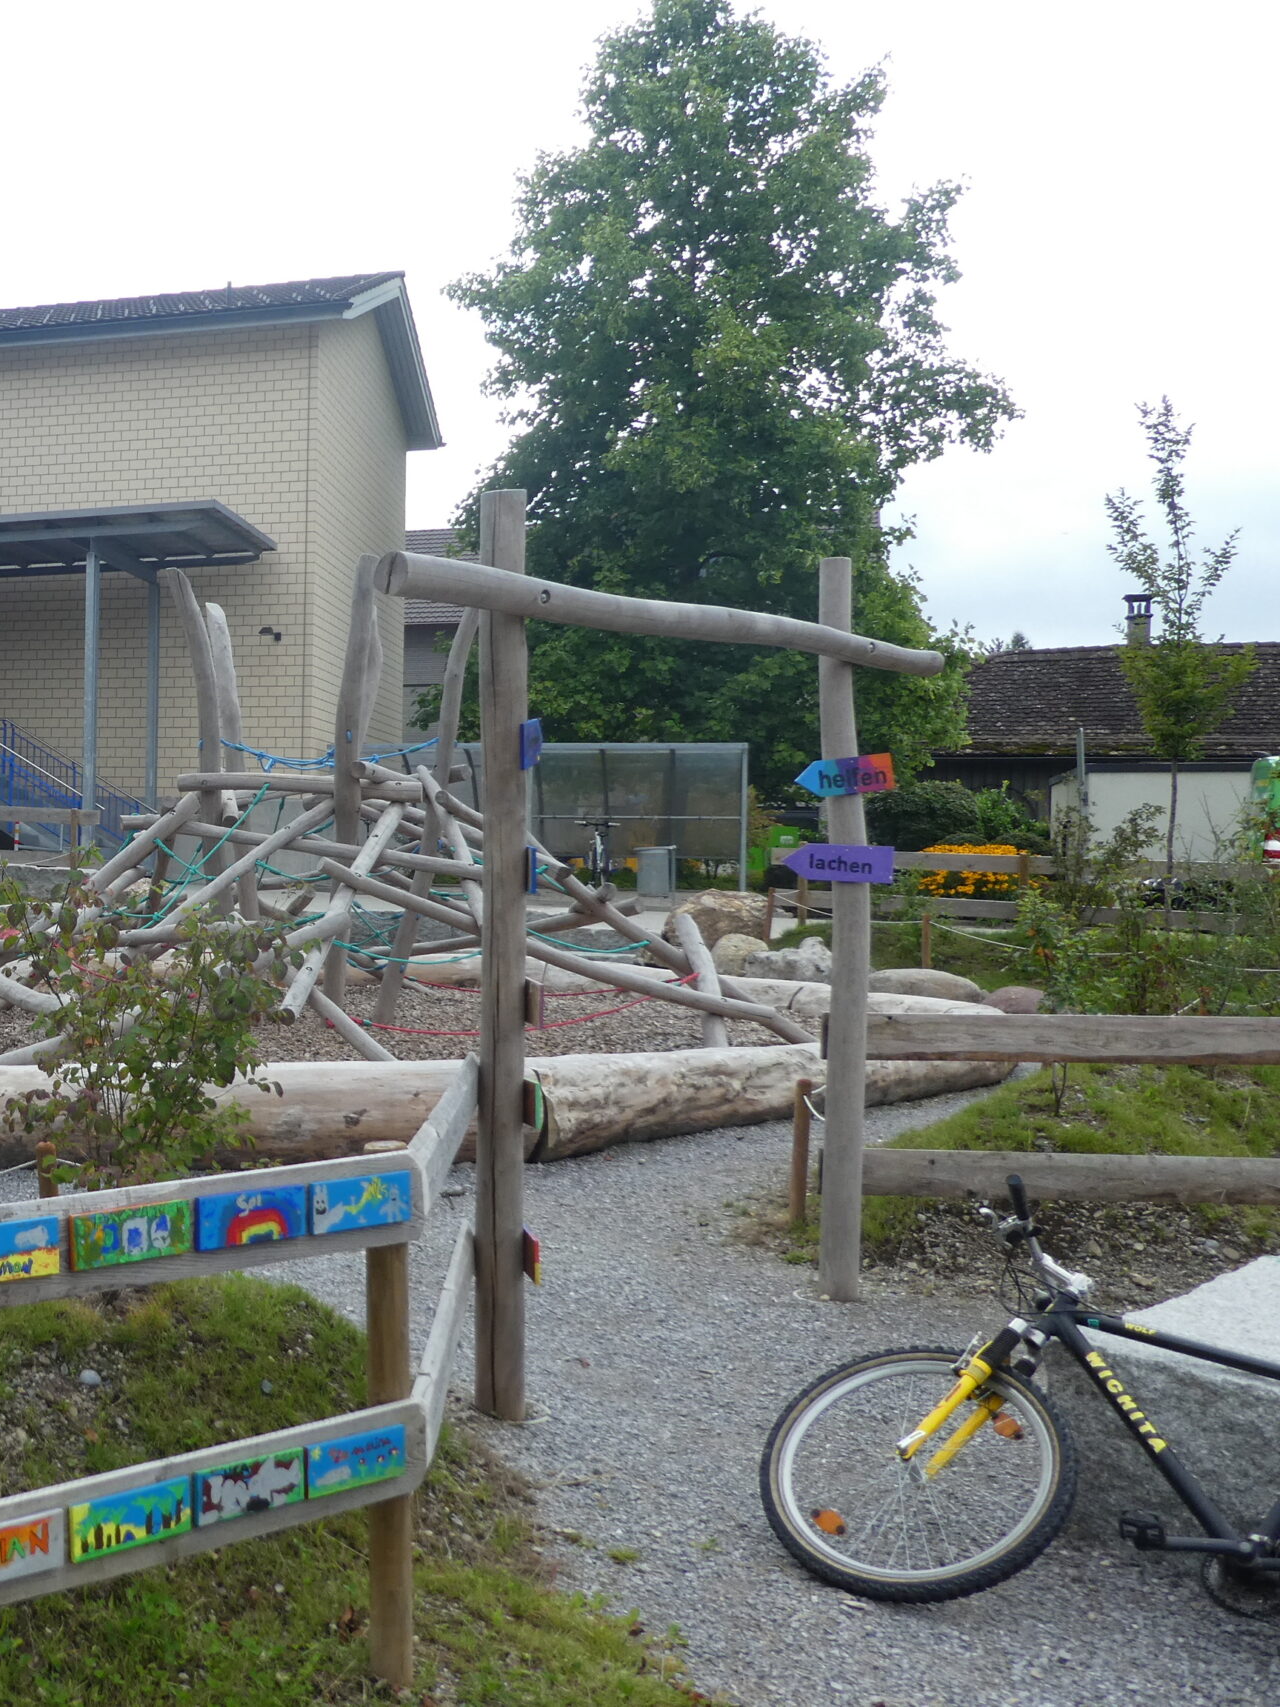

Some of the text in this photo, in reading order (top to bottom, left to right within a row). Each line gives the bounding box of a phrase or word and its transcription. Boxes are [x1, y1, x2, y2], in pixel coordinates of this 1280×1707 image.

[817, 767, 888, 790] helfen
[809, 853, 873, 875] lachen
[1124, 1322, 1158, 1336] WOLF
